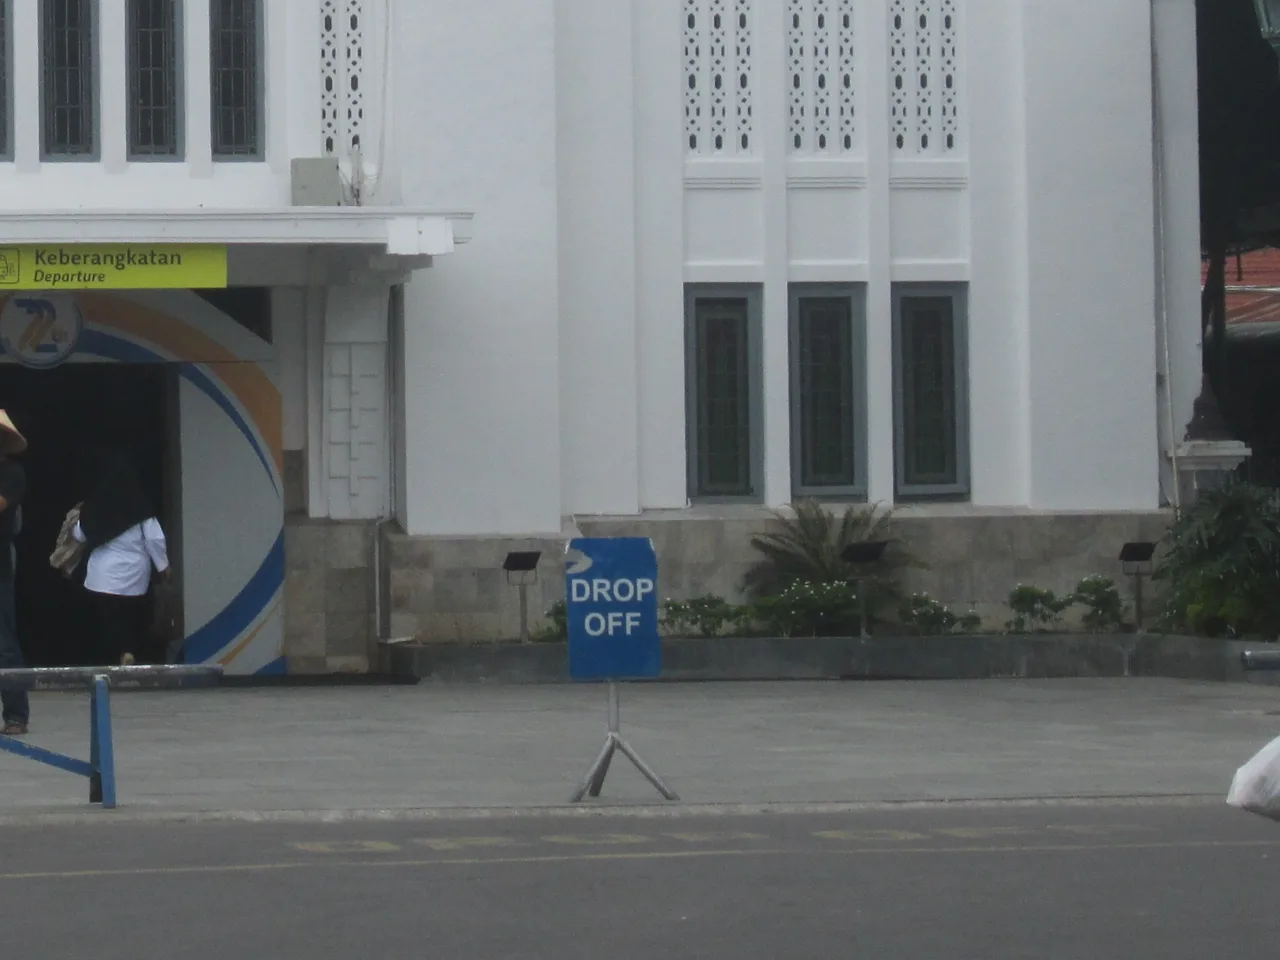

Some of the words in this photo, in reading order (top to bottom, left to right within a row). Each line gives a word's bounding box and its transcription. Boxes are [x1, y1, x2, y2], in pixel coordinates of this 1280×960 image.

[34, 248, 182, 270] Keberangkatan
[33, 269, 106, 286] Departure
[571, 578, 654, 602] DROP
[584, 612, 642, 637] OFF
